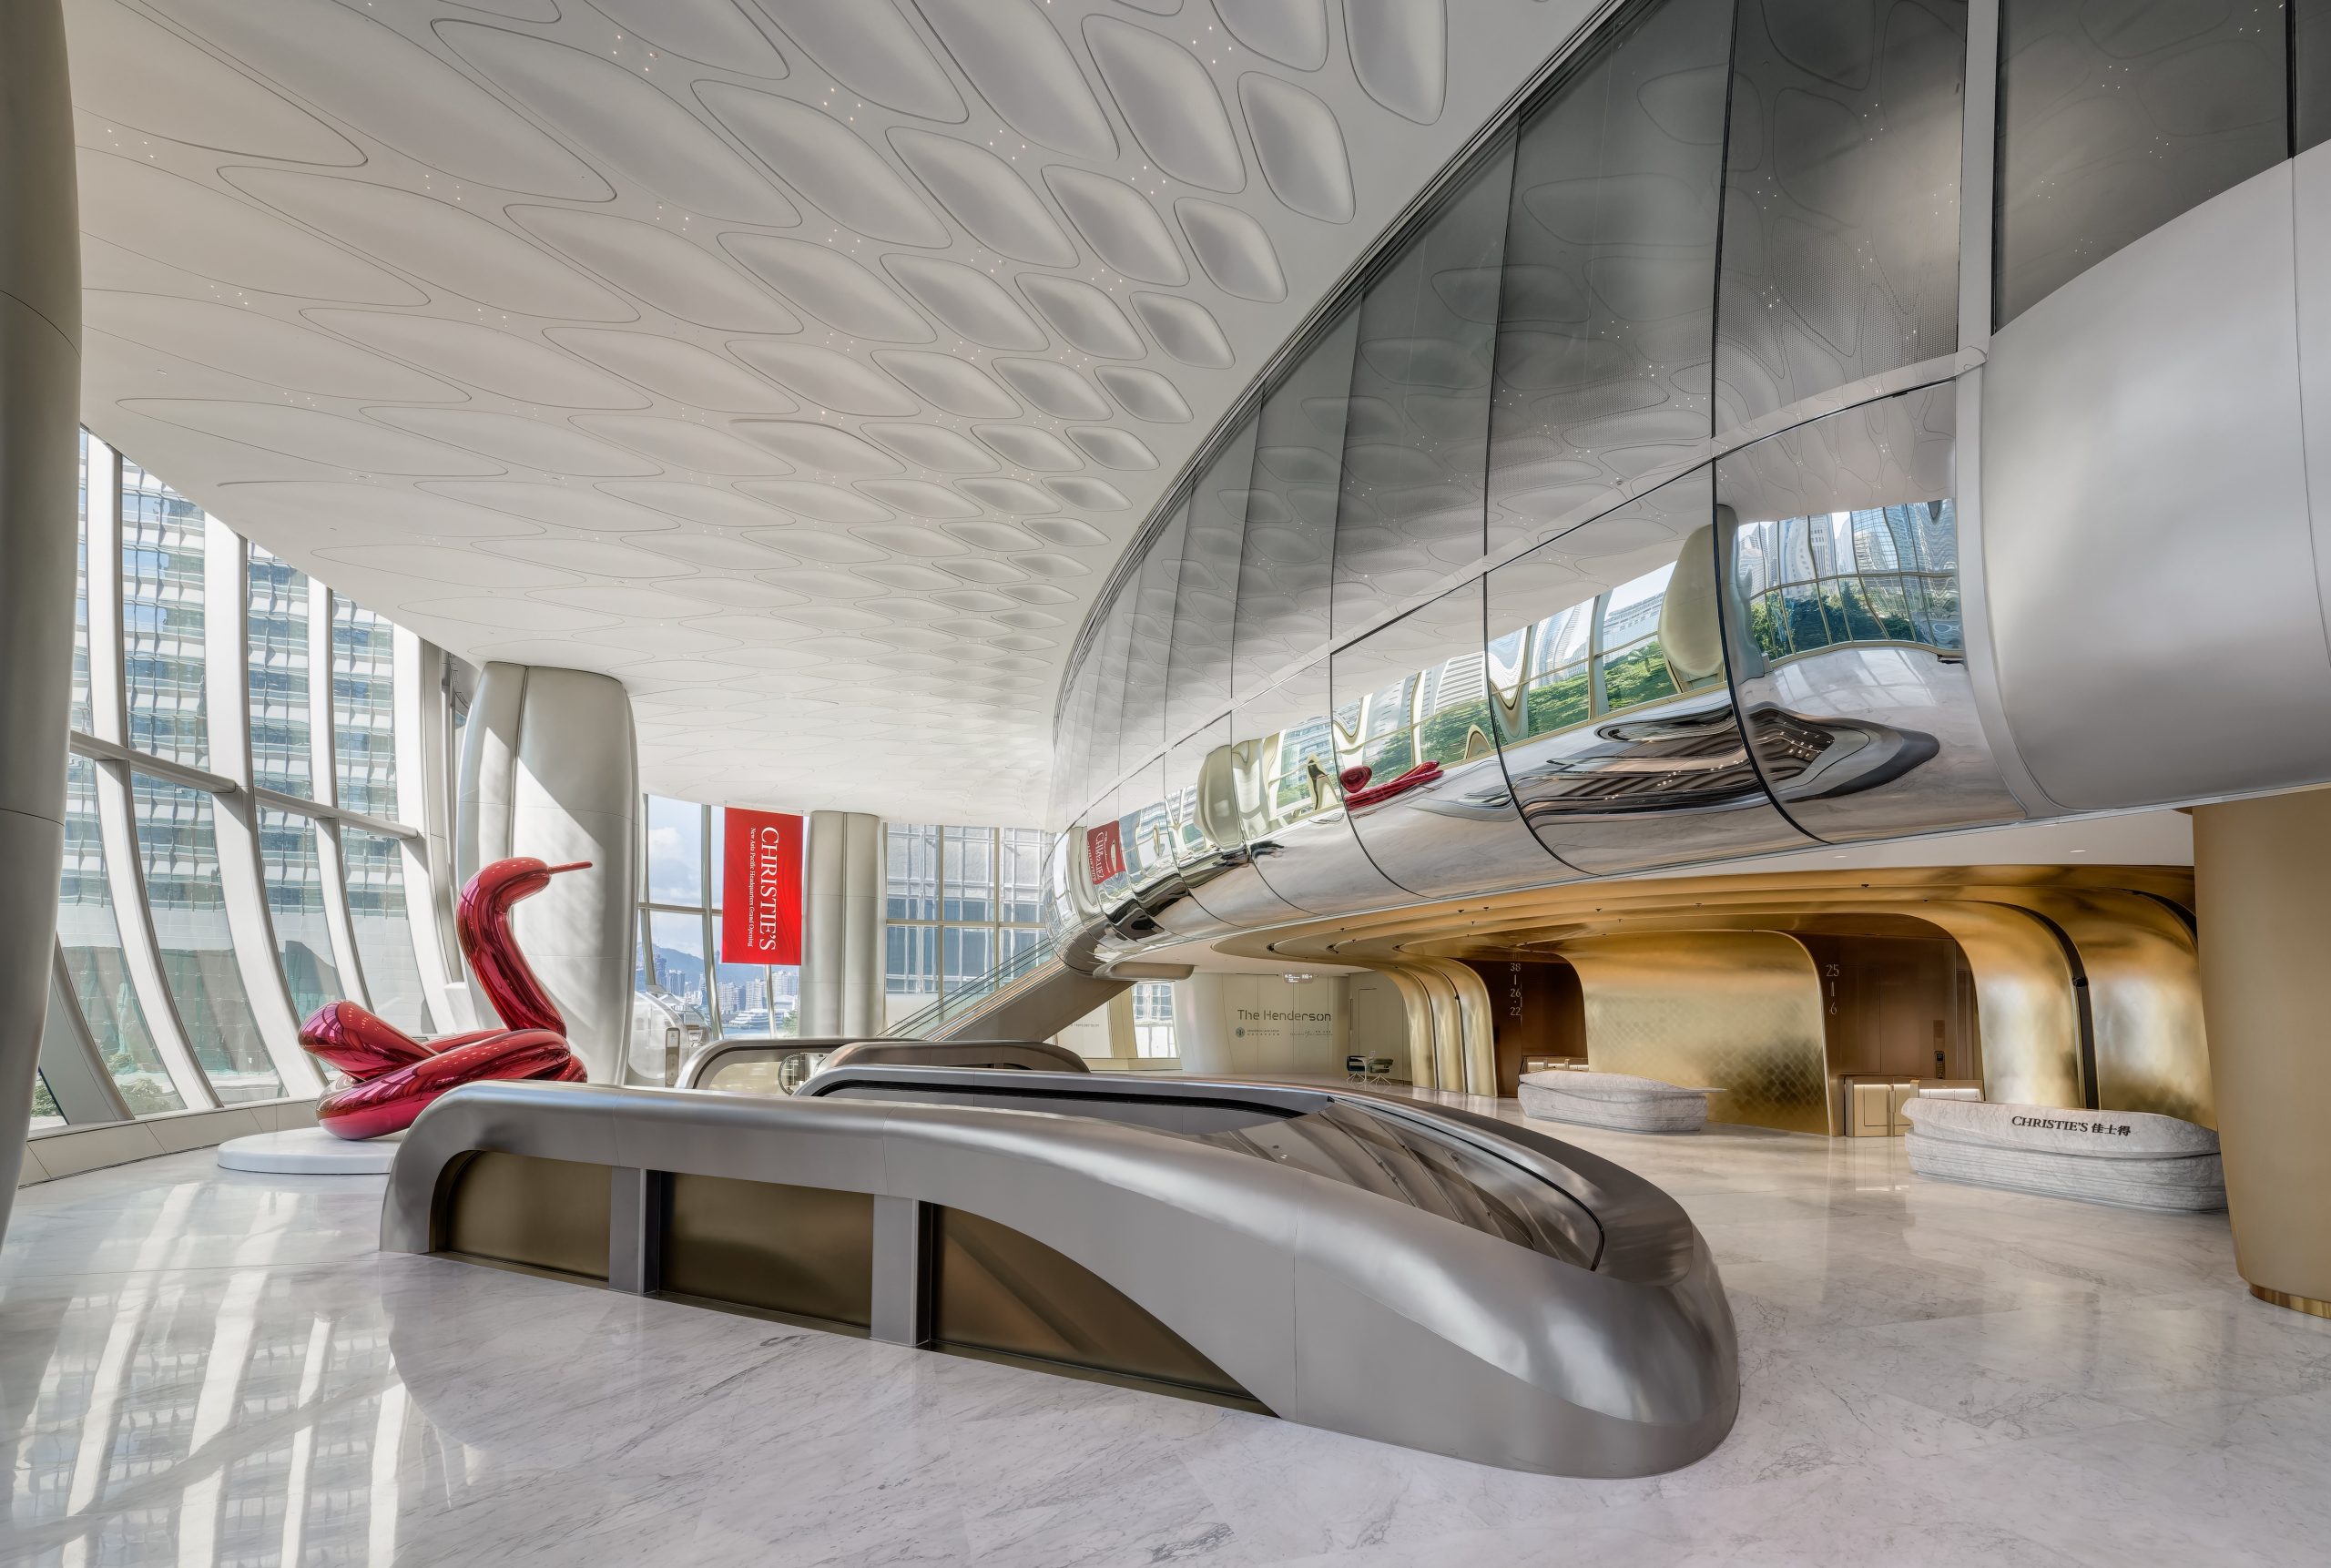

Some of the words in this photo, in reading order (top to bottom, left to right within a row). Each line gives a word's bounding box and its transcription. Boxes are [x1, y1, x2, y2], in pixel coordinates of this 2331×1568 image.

[748, 871, 756, 905] Headquarters
[759, 827, 779, 951] CHRISTIE'S
[747, 924, 755, 947] Opening
[1510, 962, 1521, 972] 38
[1826, 964, 1839, 977] 25
[1510, 988, 1521, 998] 26
[1510, 1007, 1521, 1016] 22
[1829, 1002, 1837, 1015] 6
[1237, 1009, 1259, 1020] The
[1264, 1009, 1331, 1022] Henderson
[2011, 1115, 2088, 1133] CHRISTIE'S
[2091, 1123, 2132, 1136] 佳士得
